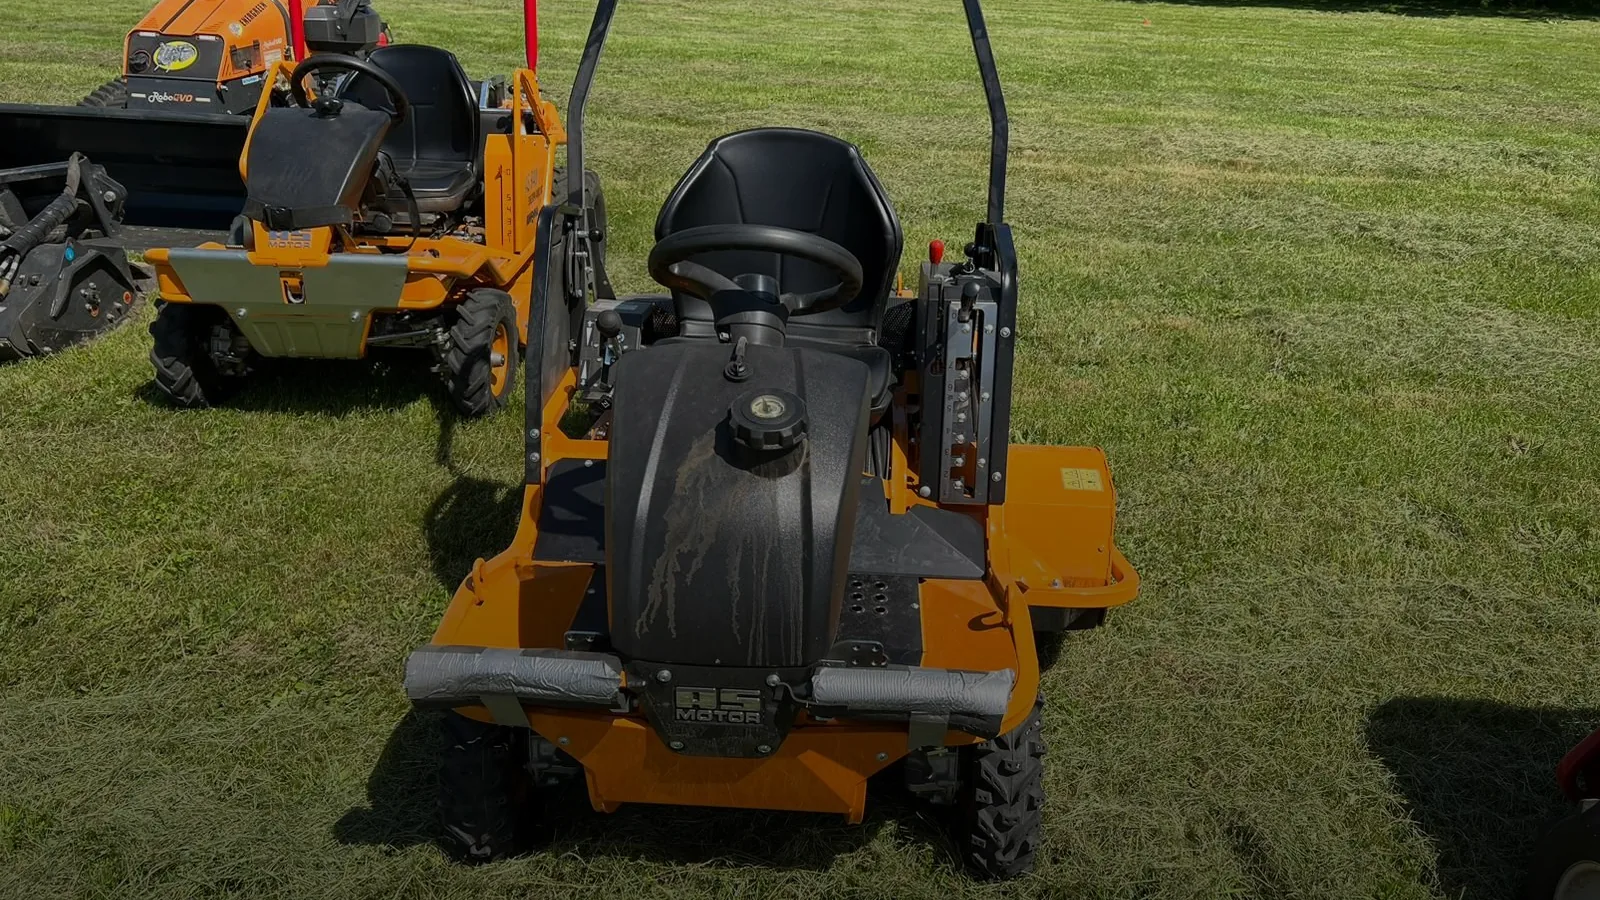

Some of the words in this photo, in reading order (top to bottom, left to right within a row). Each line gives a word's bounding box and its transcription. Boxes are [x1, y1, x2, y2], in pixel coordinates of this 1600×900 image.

[239, 2, 268, 27] ENERGREEN
[269, 241, 311, 249] MOTOR
[676, 686, 761, 711] AS
[676, 709, 761, 724] MOTOR
